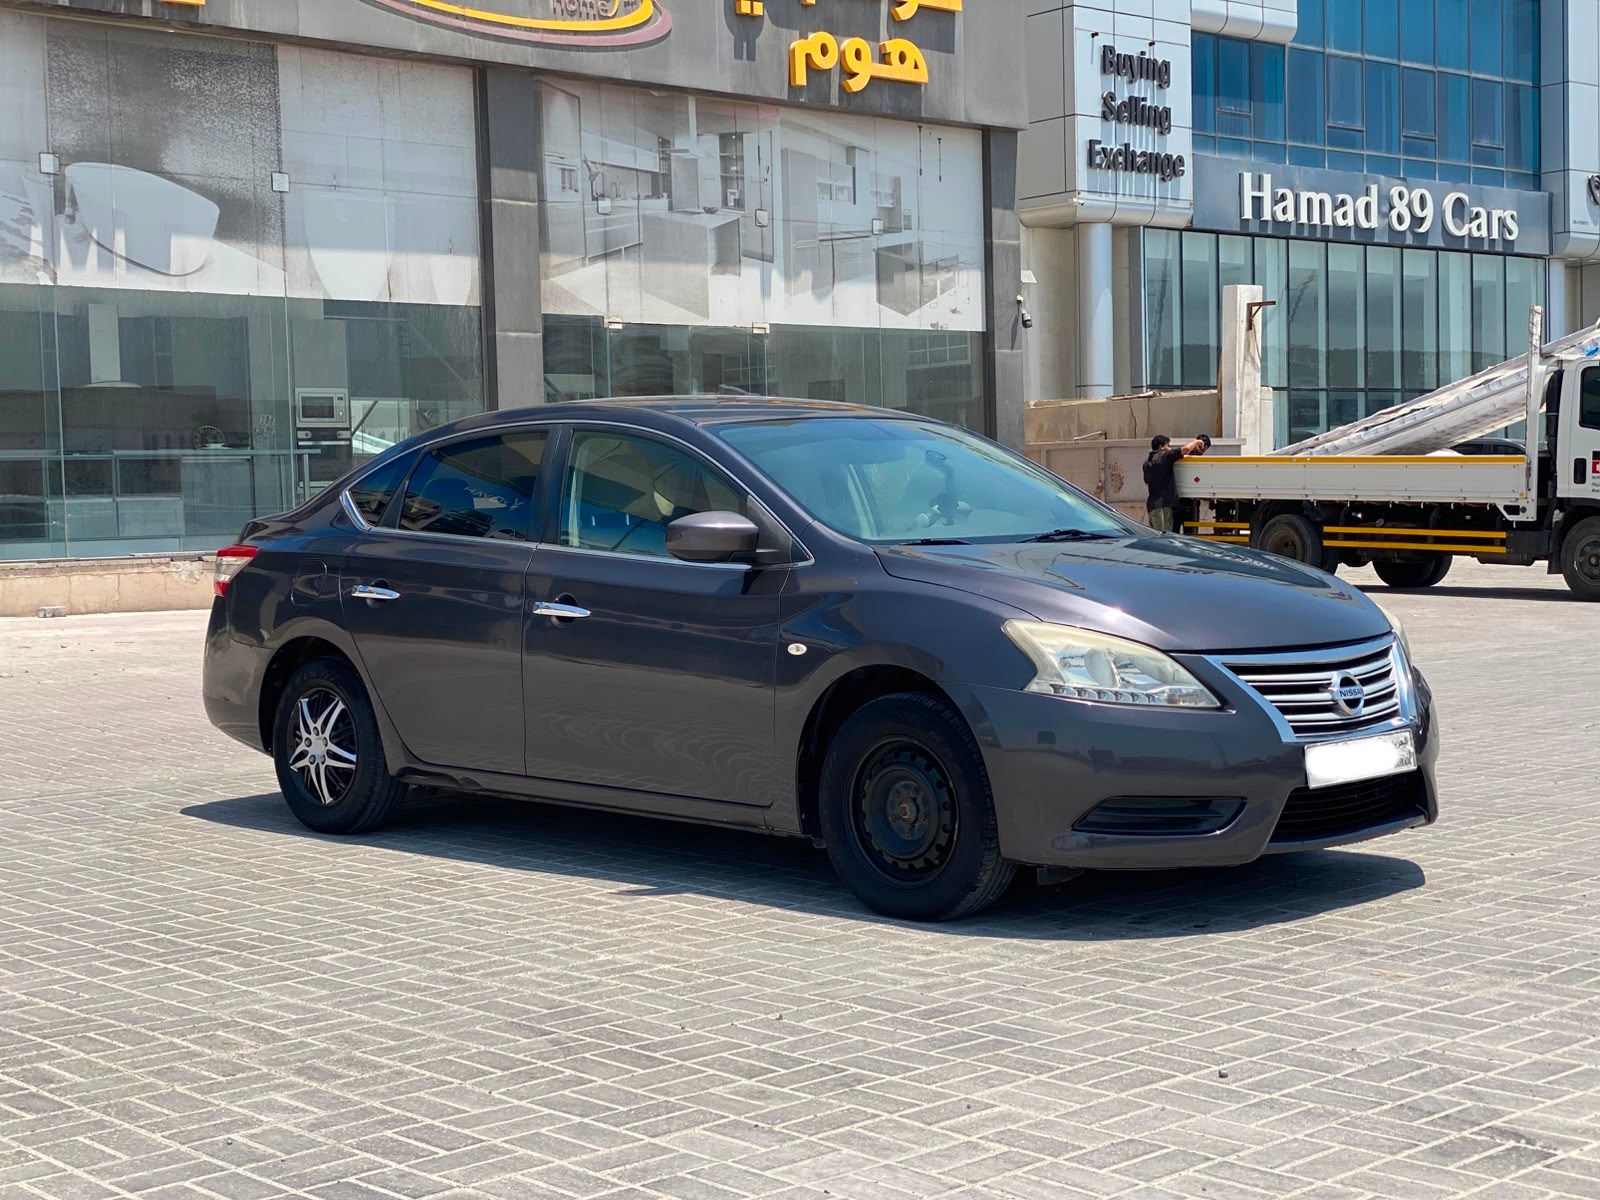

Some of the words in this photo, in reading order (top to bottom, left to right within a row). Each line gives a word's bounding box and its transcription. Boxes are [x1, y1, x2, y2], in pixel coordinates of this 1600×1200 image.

[790, 31, 929, 93] هوم
[1101, 44, 1171, 89] Buying
[1101, 90, 1172, 136] Selling
[1087, 138, 1185, 182] Exchange
[1239, 172, 1379, 230] Hamad
[1388, 186, 1434, 233] 89
[1442, 192, 1519, 241] Cars
